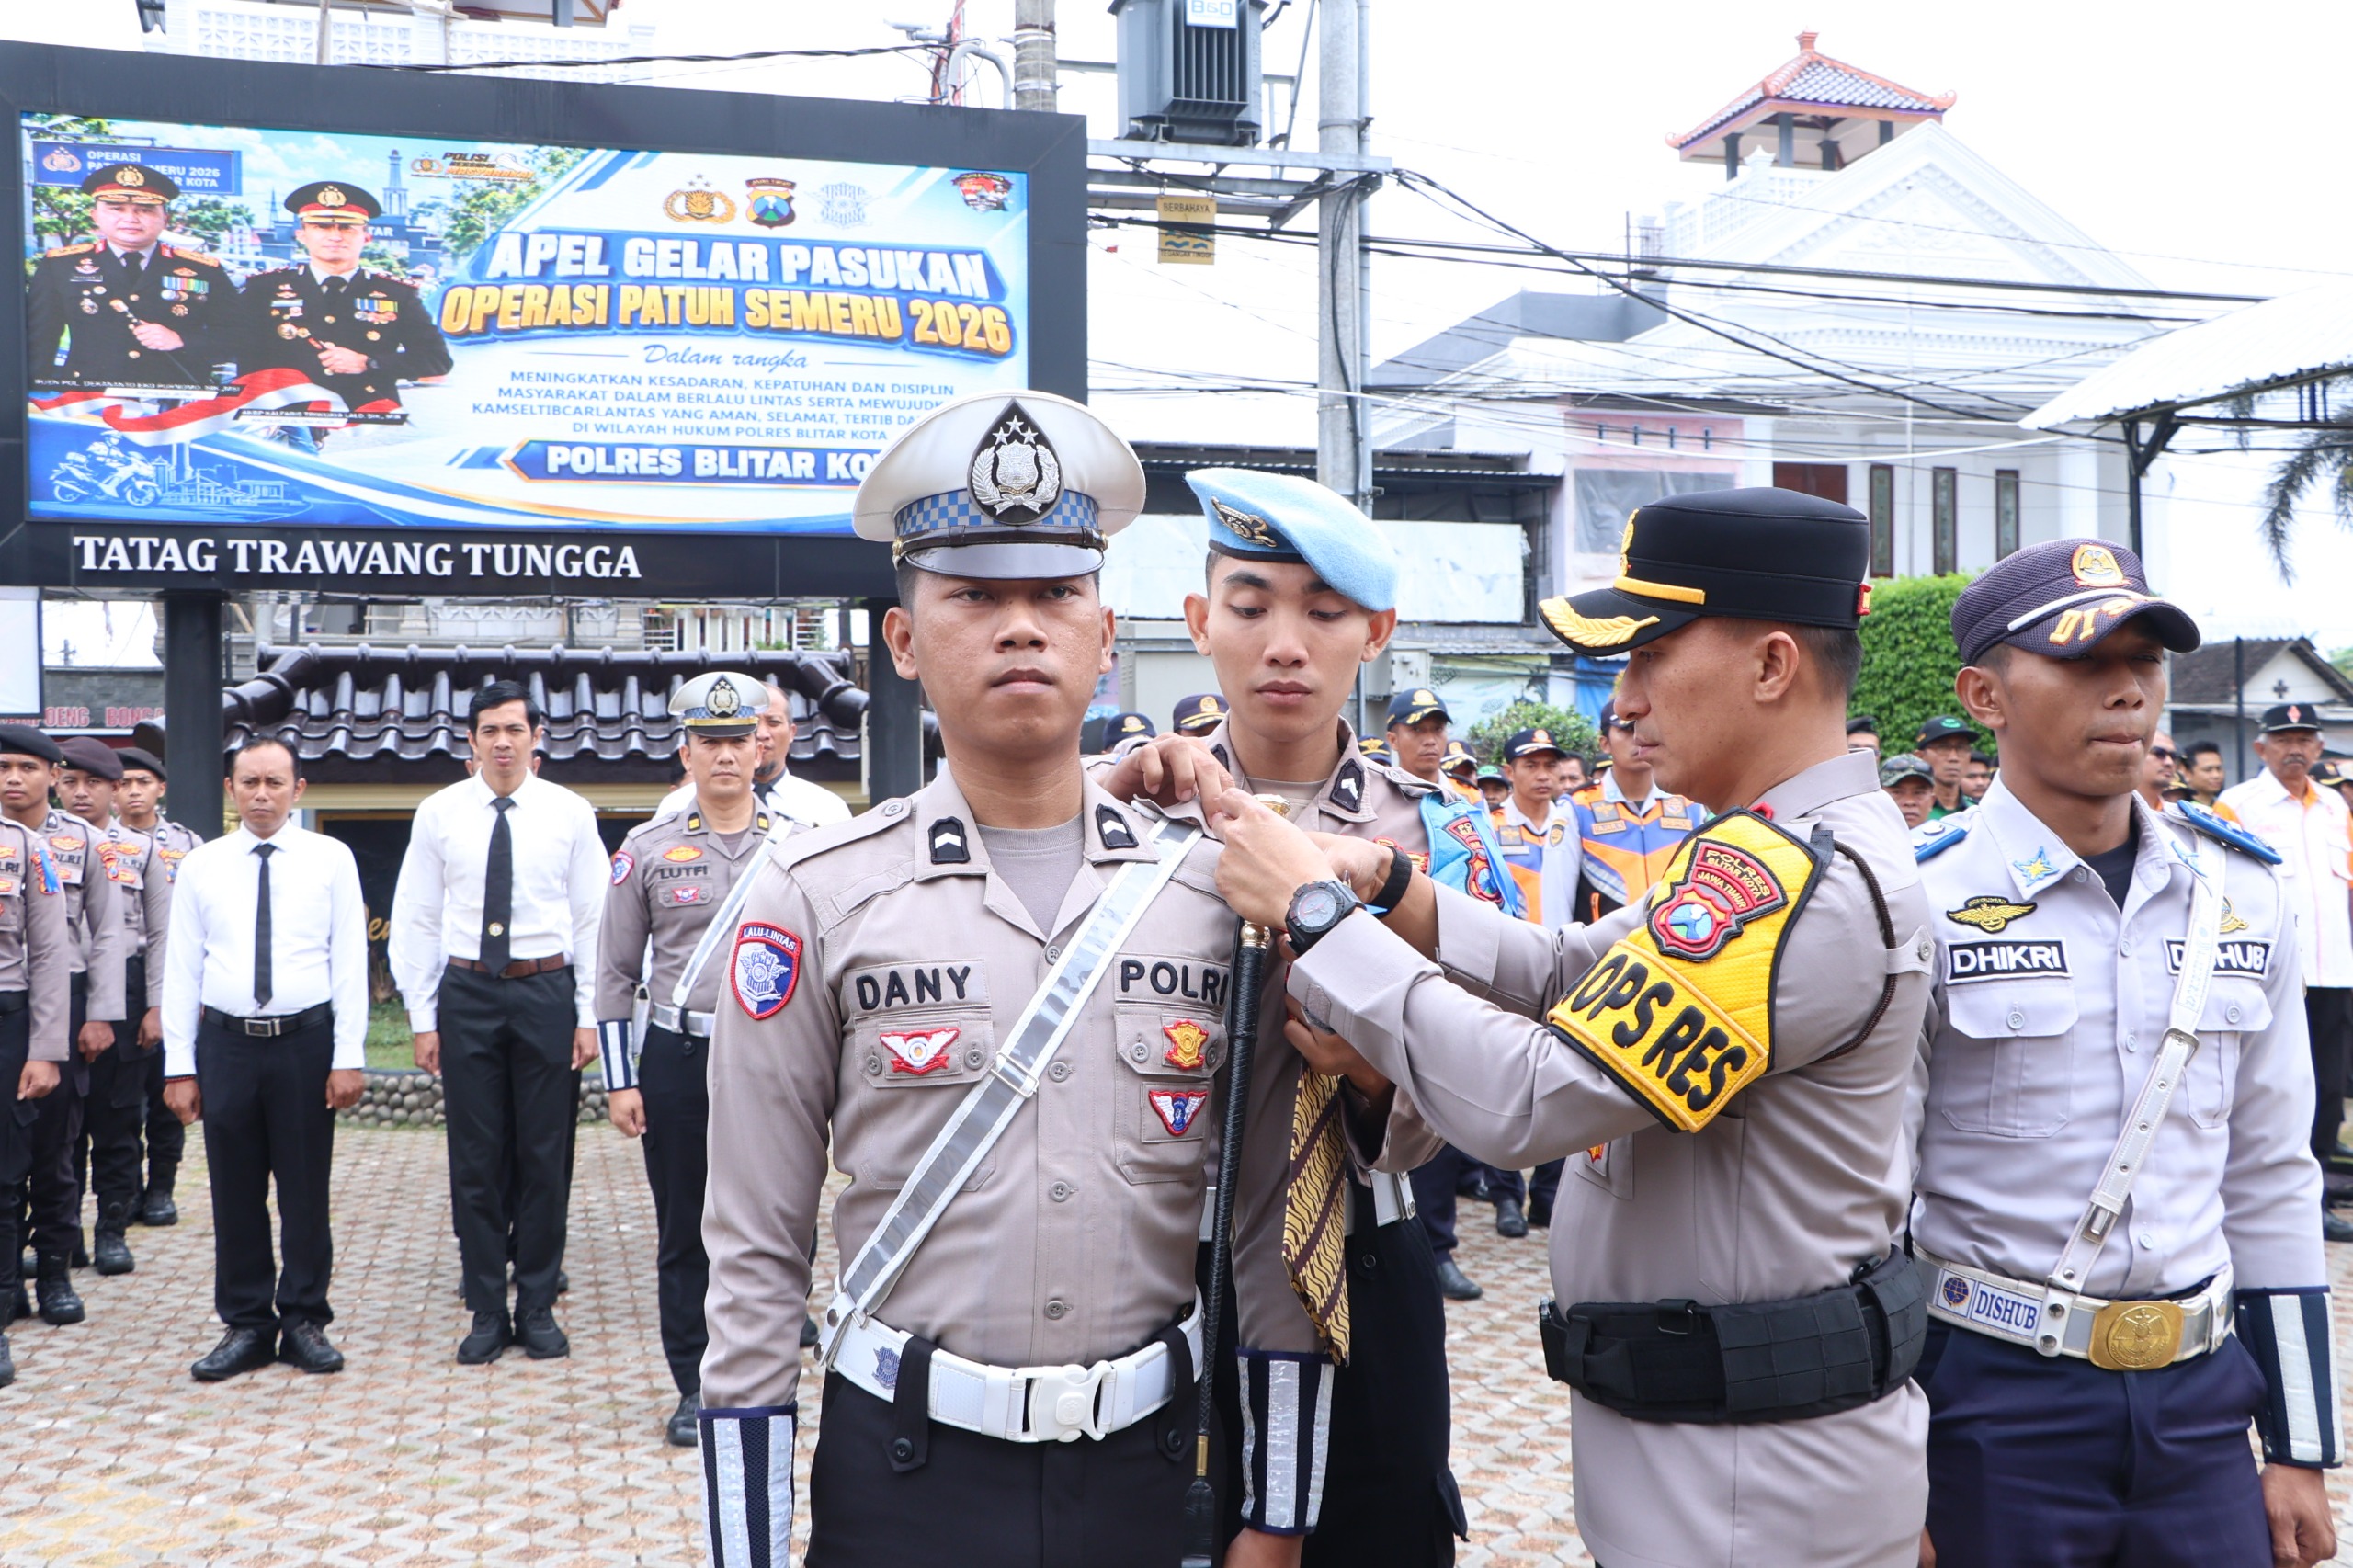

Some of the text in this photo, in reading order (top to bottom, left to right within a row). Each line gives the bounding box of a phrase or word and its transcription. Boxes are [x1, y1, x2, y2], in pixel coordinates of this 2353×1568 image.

[86, 150, 142, 163] OPERASI
[442, 152, 491, 163] POLISI
[186, 176, 219, 188] KOTA
[189, 166, 221, 177] 2026
[1163, 202, 1211, 213] BERBAHAYA
[485, 232, 990, 299] APEL GELAR PASUKAN
[441, 284, 1012, 354] OPERASI PATUH SEMERU 2026
[643, 344, 809, 373] Dalam rangka
[511, 371, 955, 396] MENINGKATKAN KESADARAN, KEPATUHAN DAN DISIPLIN
[498, 387, 944, 410] MASYARAKAT DALAM BERLALU LINTAS SERTA MEWUJUDK
[472, 403, 656, 419] KAMSELTIBCARLANTAS
[662, 408, 704, 420] YANG
[844, 413, 893, 426] TERTIB
[897, 415, 921, 426] DA
[573, 422, 888, 441] DI WILAYAH HUKUM POLRES BLITAR KOTA
[547, 445, 881, 481] POLRES BLITAR KO
[74, 536, 642, 579] TATAG TRAWANG TUNGGA
[661, 865, 709, 879] LUTFI
[1706, 849, 1771, 897] POLRES
[1708, 857, 1761, 898] BLITAR KOTA
[1698, 871, 1747, 909] JAWA TIMUR
[1952, 945, 2063, 974] DHIKRI
[856, 965, 971, 1010] DANY
[1121, 960, 1230, 1006] POLRI
[1570, 953, 1748, 1112] OPS RES
[1974, 1290, 2039, 1330] DISHUB
